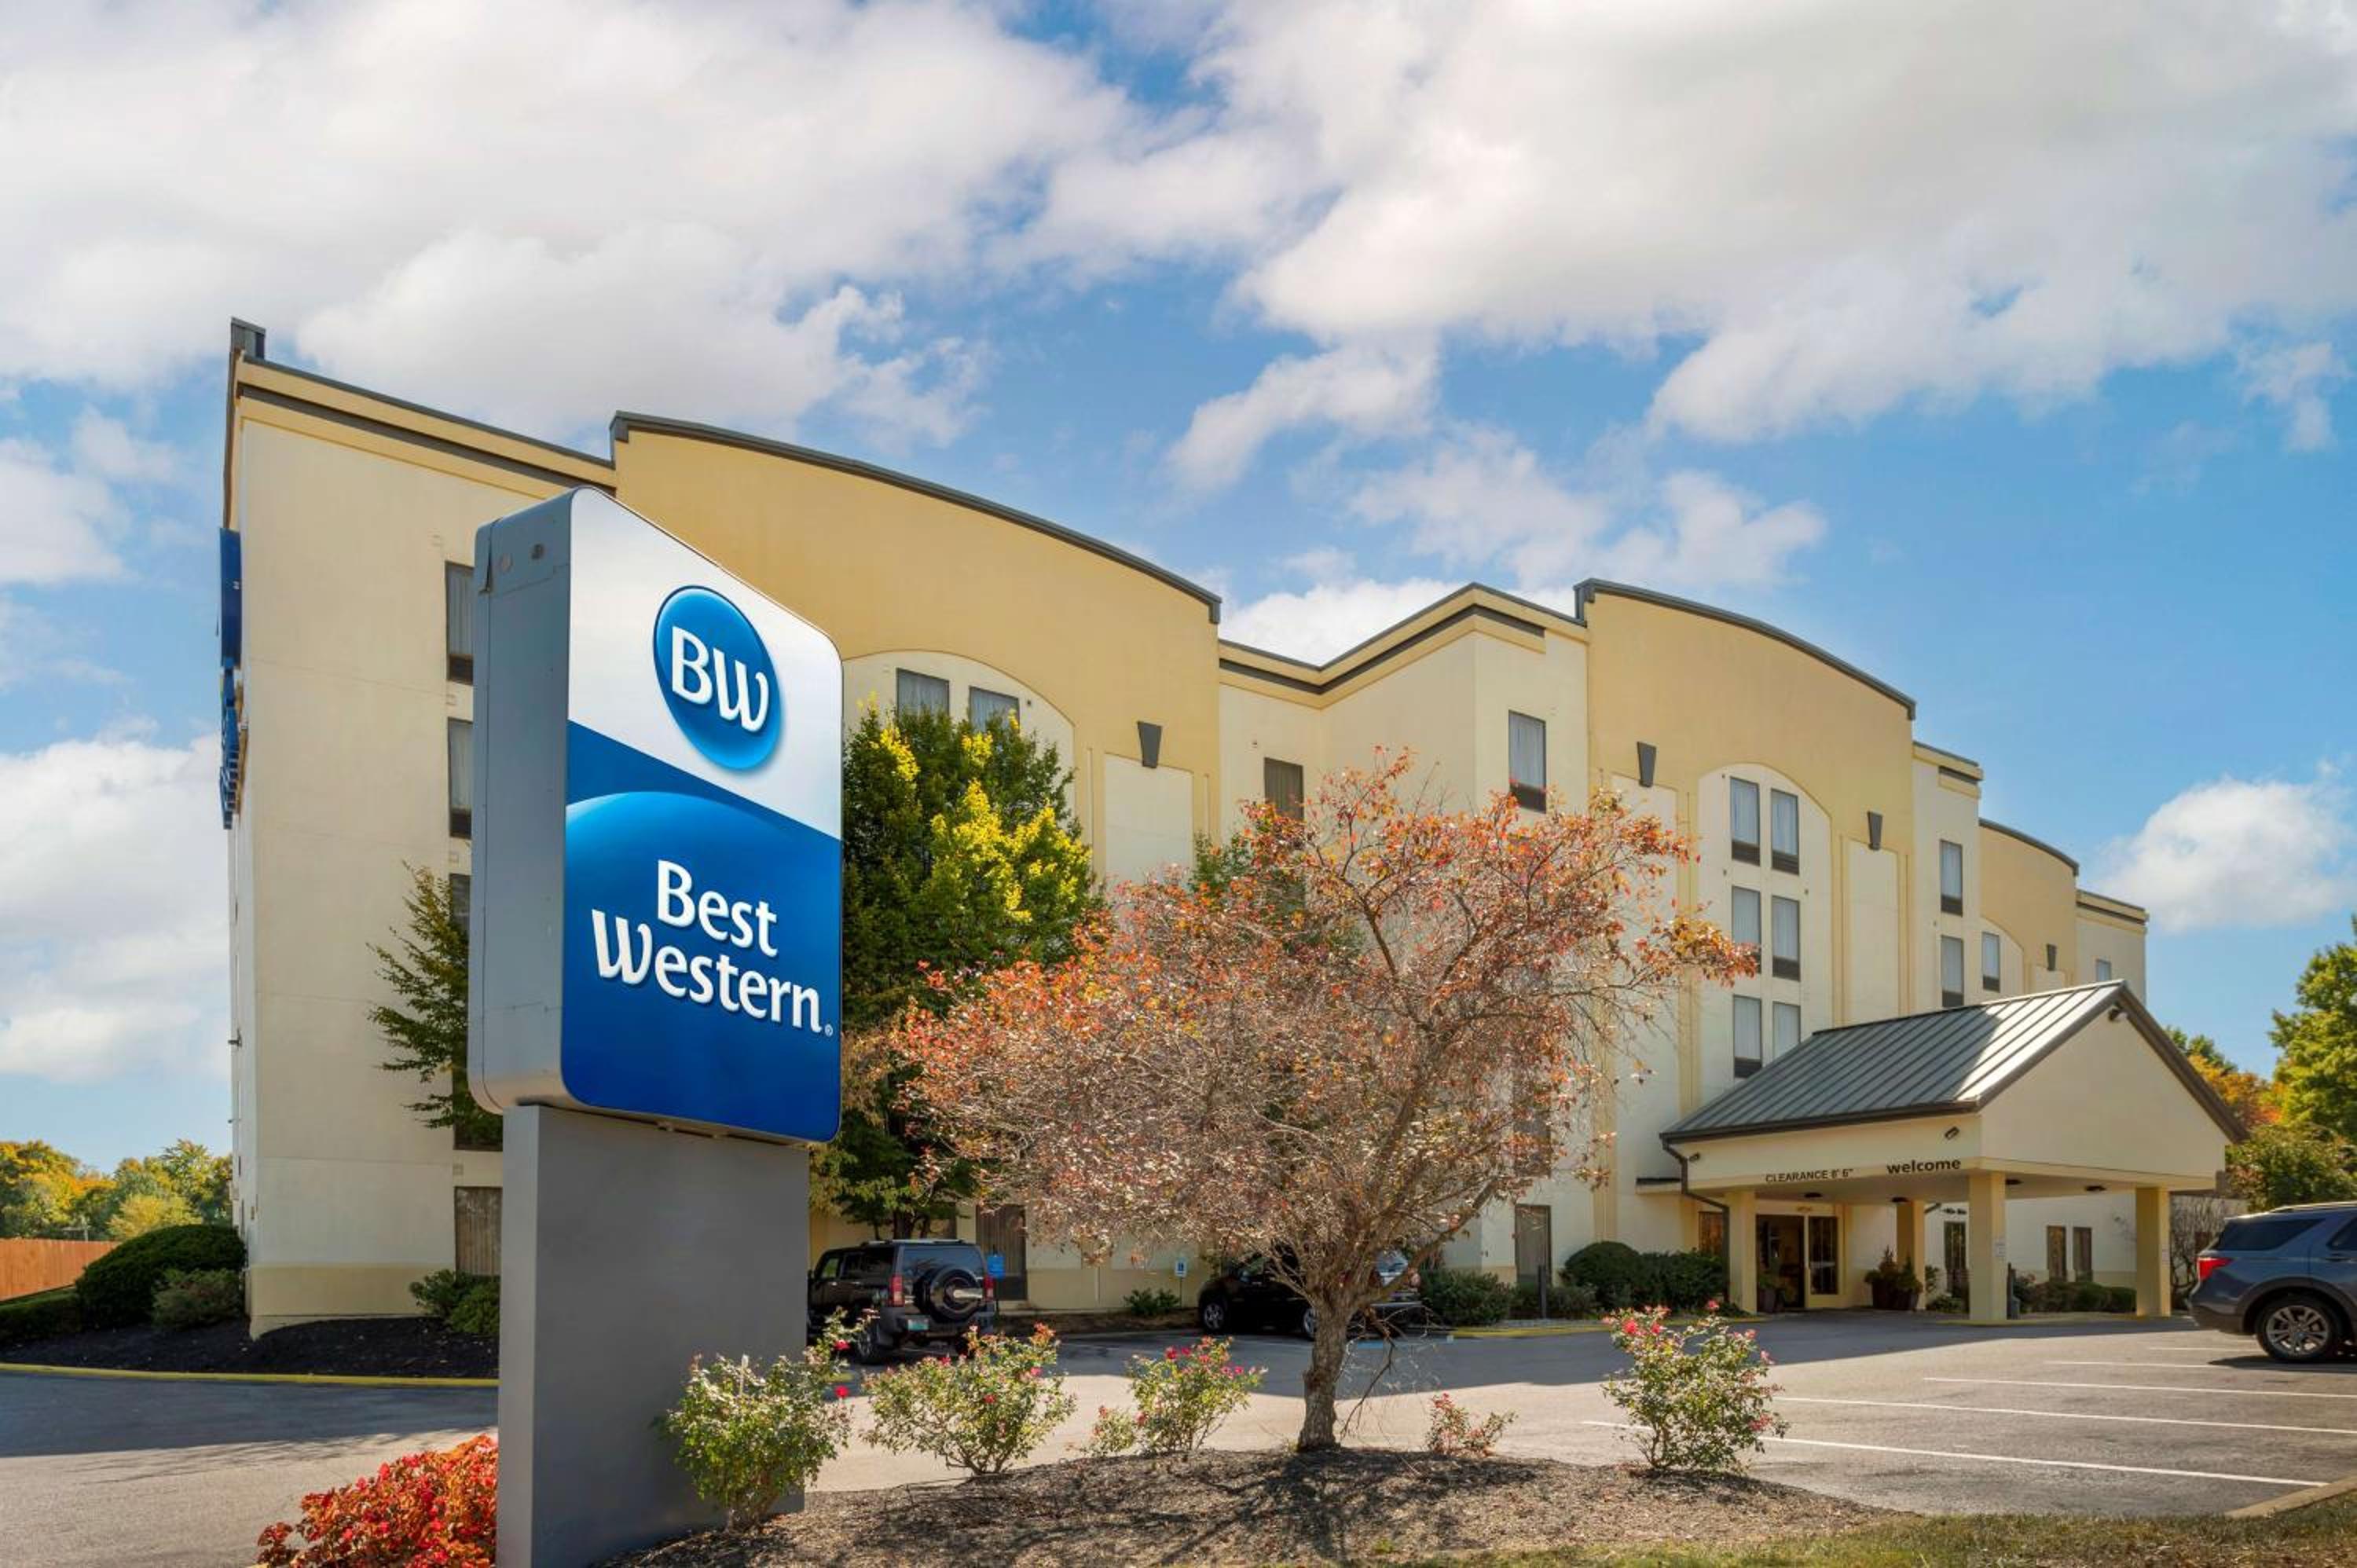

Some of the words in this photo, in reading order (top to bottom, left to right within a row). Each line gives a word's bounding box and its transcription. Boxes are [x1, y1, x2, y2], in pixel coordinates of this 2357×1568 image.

[672, 626, 769, 733] BW
[658, 859, 778, 958] Best
[1765, 1169, 1828, 1182] CLEARANCE
[1886, 1159, 1962, 1174] welcome
